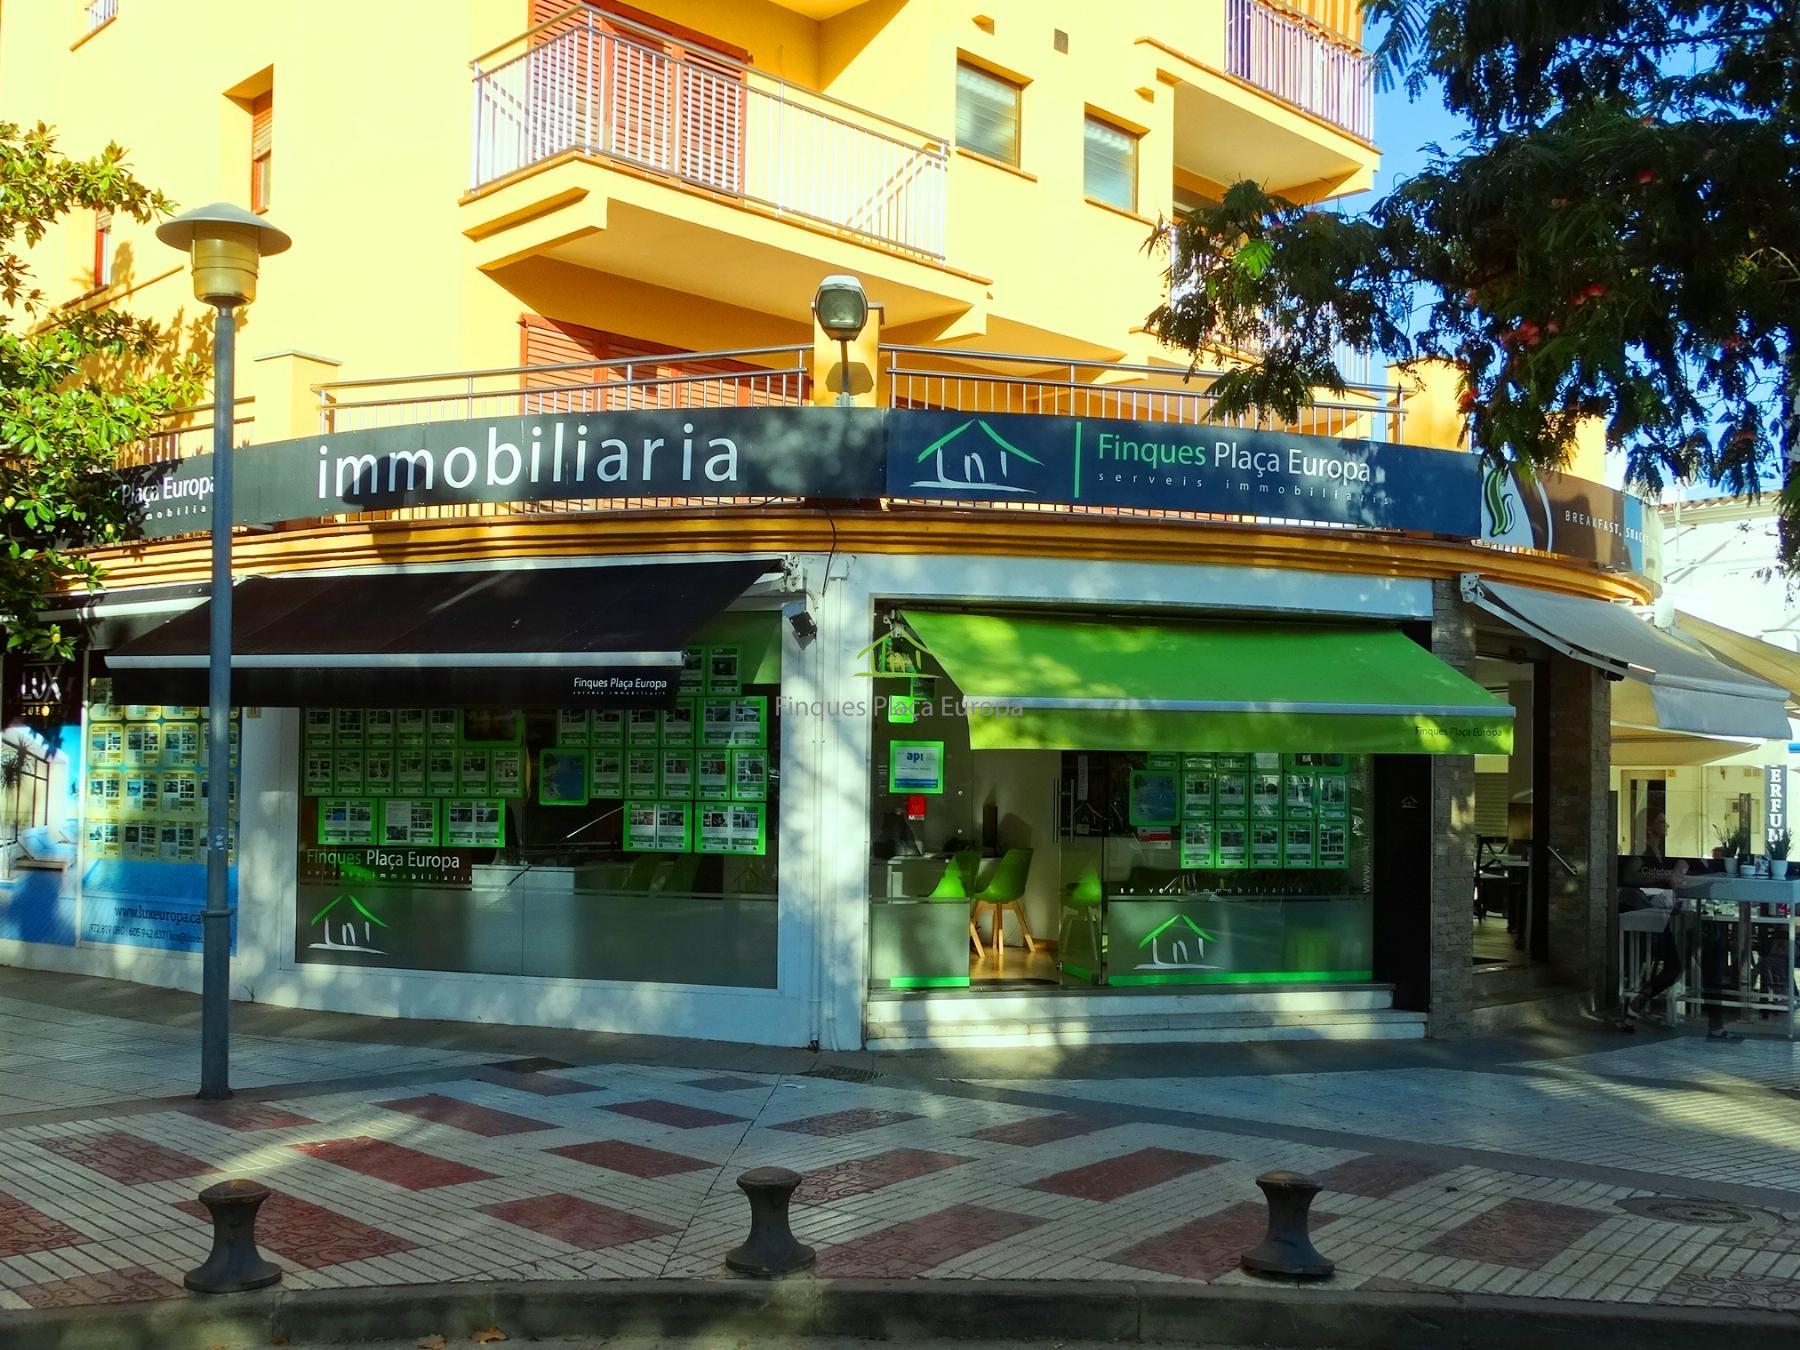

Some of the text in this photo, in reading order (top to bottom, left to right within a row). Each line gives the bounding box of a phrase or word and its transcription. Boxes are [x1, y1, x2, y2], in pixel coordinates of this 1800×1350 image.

[318, 422, 738, 499] immobiliaria
[1097, 433, 1370, 486] Finques Plaça Europa
[122, 484, 160, 508] Plaça
[1098, 473, 1391, 505] serveis immobiliaris
[22, 664, 61, 702] LUX
[574, 677, 667, 690] Finques Plaça Europa
[1415, 726, 1448, 737] Finques
[1472, 728, 1502, 738] Europa
[306, 848, 460, 872] Finques Plaça Europa
[115, 905, 203, 926] www.luxeuropa.ca
